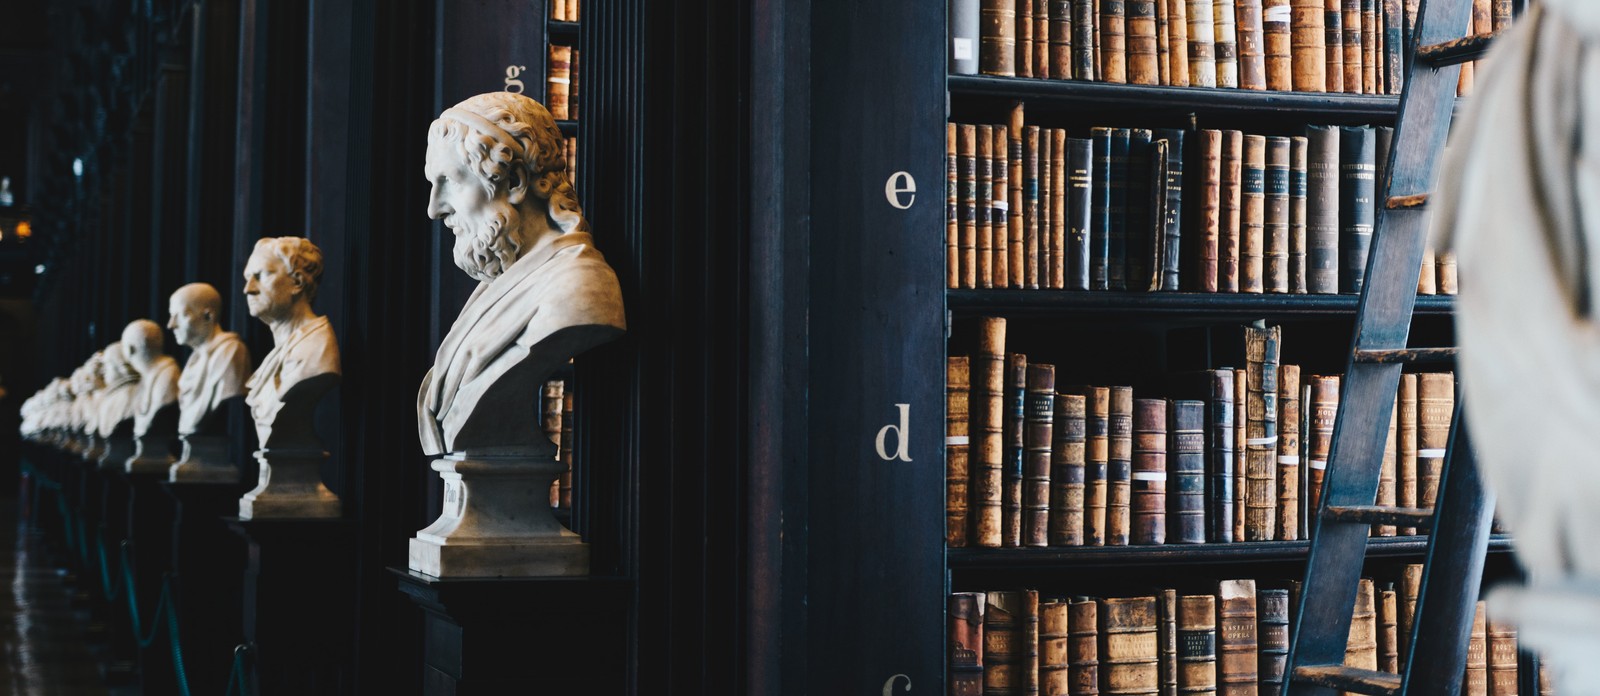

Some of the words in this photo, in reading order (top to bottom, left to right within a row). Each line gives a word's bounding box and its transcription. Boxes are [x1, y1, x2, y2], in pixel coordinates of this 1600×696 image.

[504, 65, 526, 94] g
[885, 171, 916, 209] e
[875, 403, 913, 462] d
